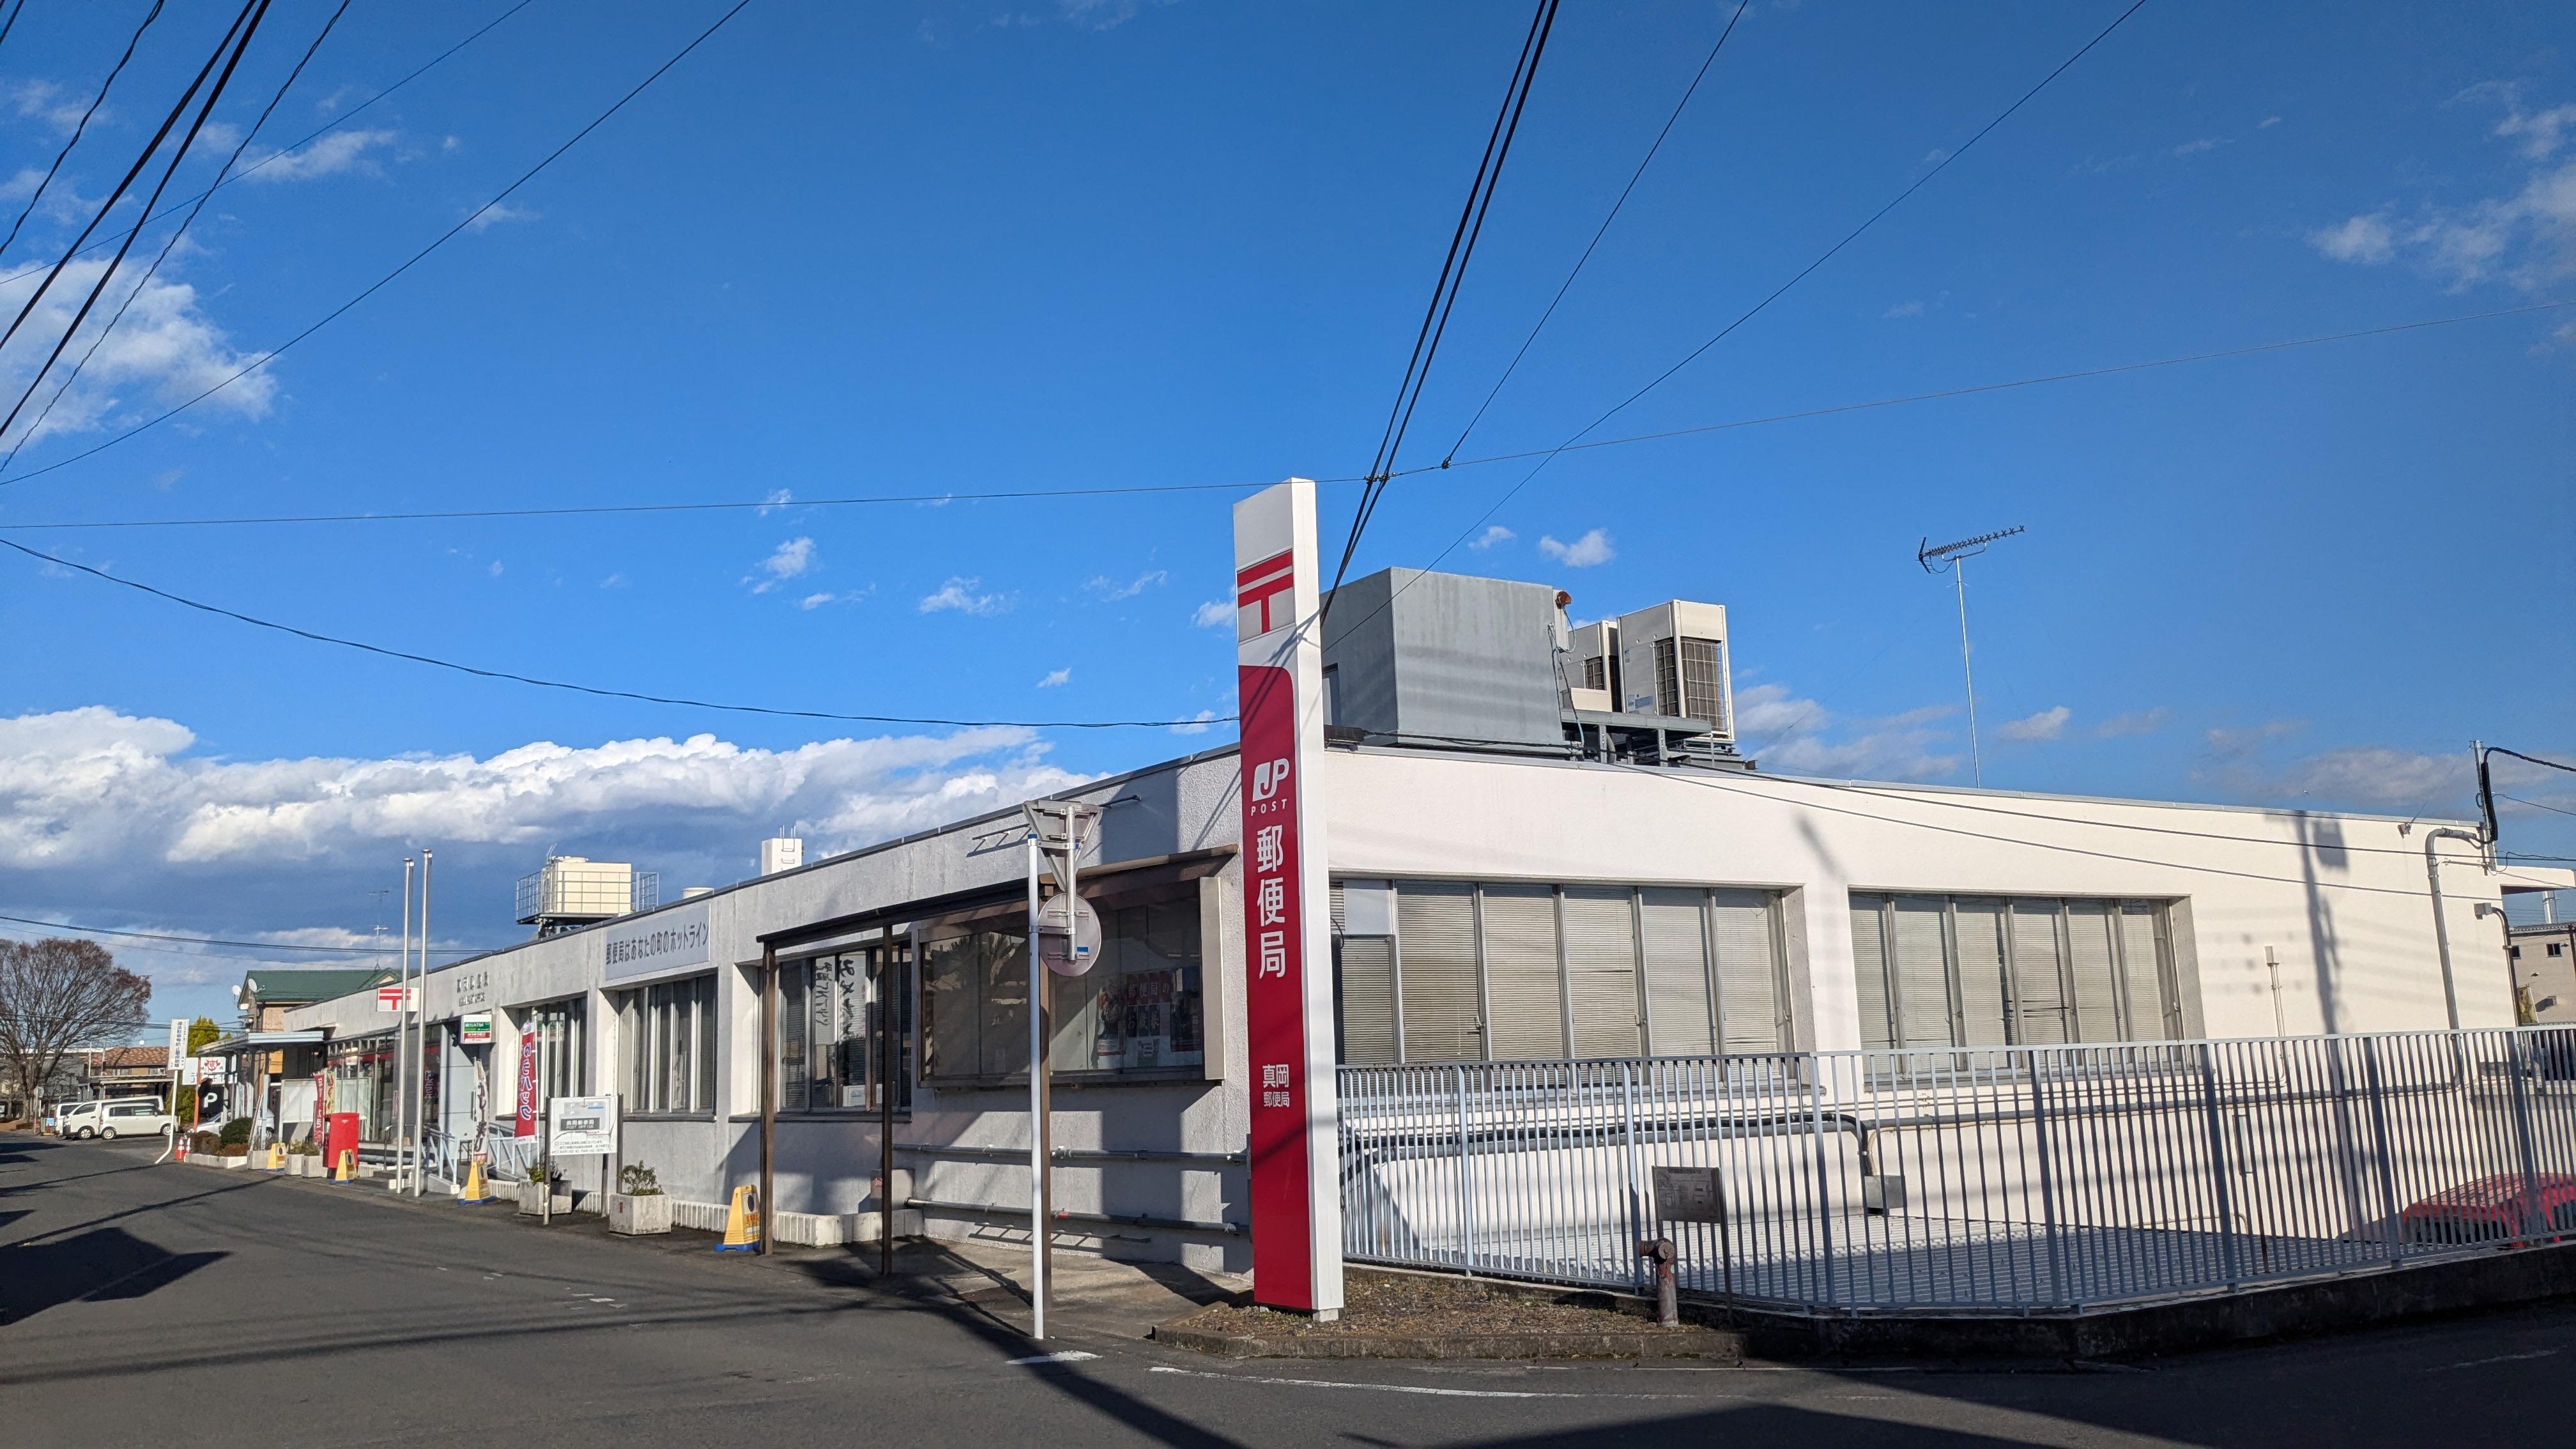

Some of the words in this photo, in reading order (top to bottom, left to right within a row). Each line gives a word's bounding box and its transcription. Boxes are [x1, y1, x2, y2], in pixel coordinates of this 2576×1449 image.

[1250, 799, 1287, 816] POST
[1257, 824, 1286, 979] 郵便局
[606, 921, 709, 965] 郵便局はあなたの町のホットライン
[1128, 981, 1170, 998] 郵便局の
[1128, 1011, 1160, 1030] お歳暮
[520, 1042, 533, 1121] ゆうパック
[1262, 1064, 1289, 1088] 真岡
[204, 1092, 218, 1108] P
[1263, 1091, 1290, 1107] 郵便局
